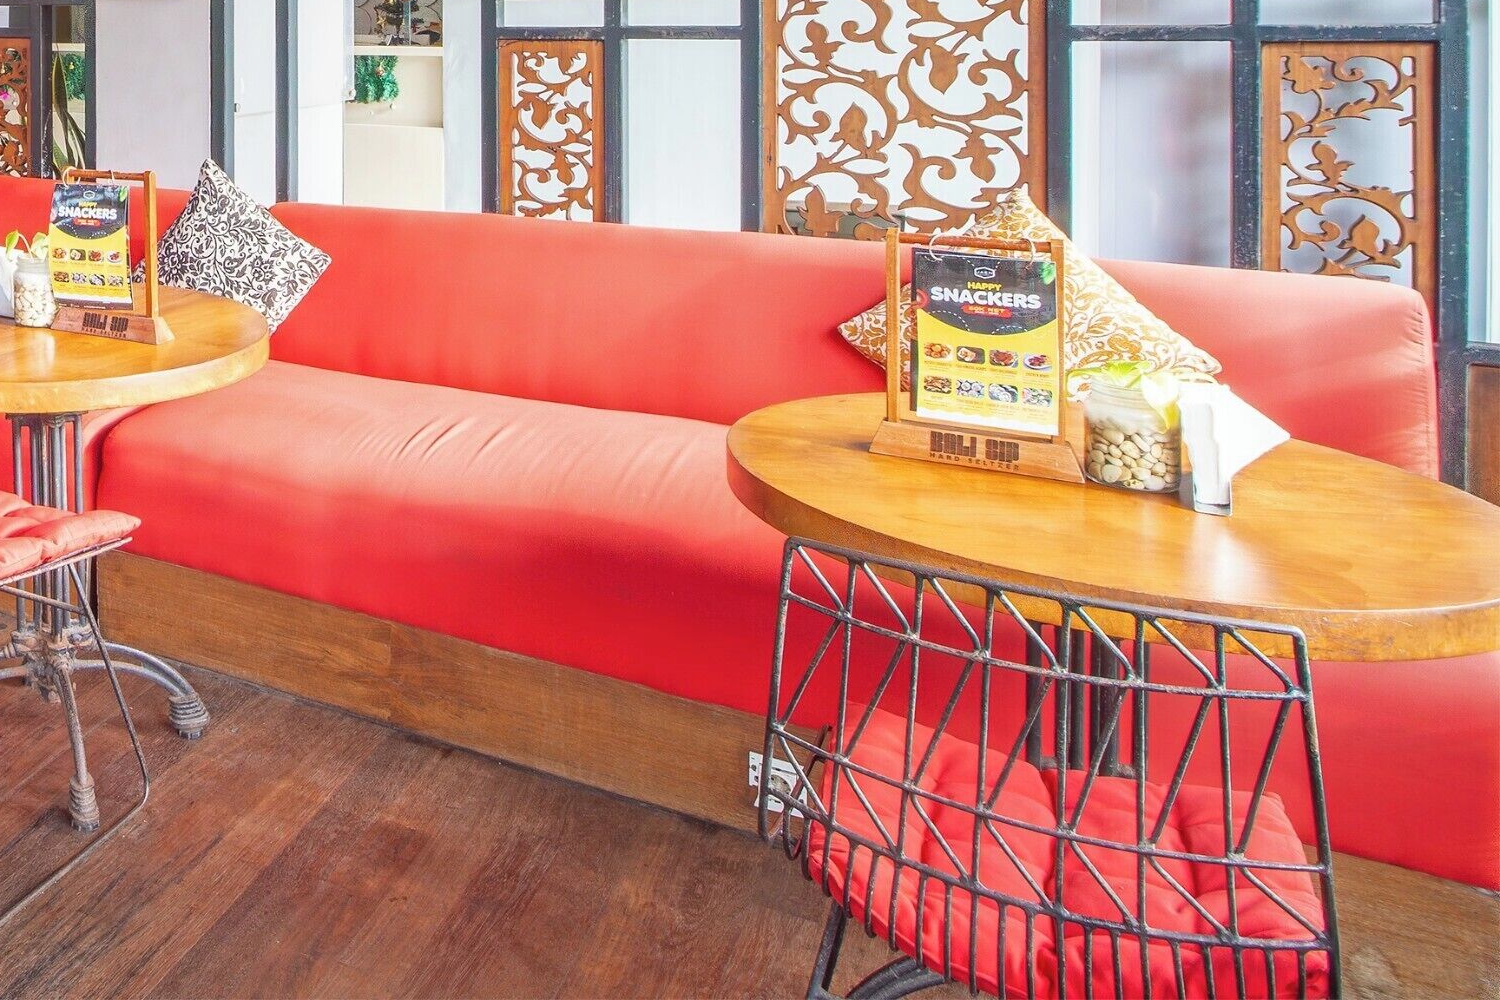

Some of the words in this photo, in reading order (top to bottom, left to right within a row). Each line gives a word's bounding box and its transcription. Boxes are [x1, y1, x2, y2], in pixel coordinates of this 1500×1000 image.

[58, 206, 118, 220] SNACKERS
[967, 281, 1002, 292] HAPPY
[930, 286, 1042, 309] SNACKERS
[929, 452, 961, 462] HARD
[967, 457, 1020, 471] SELTZER
